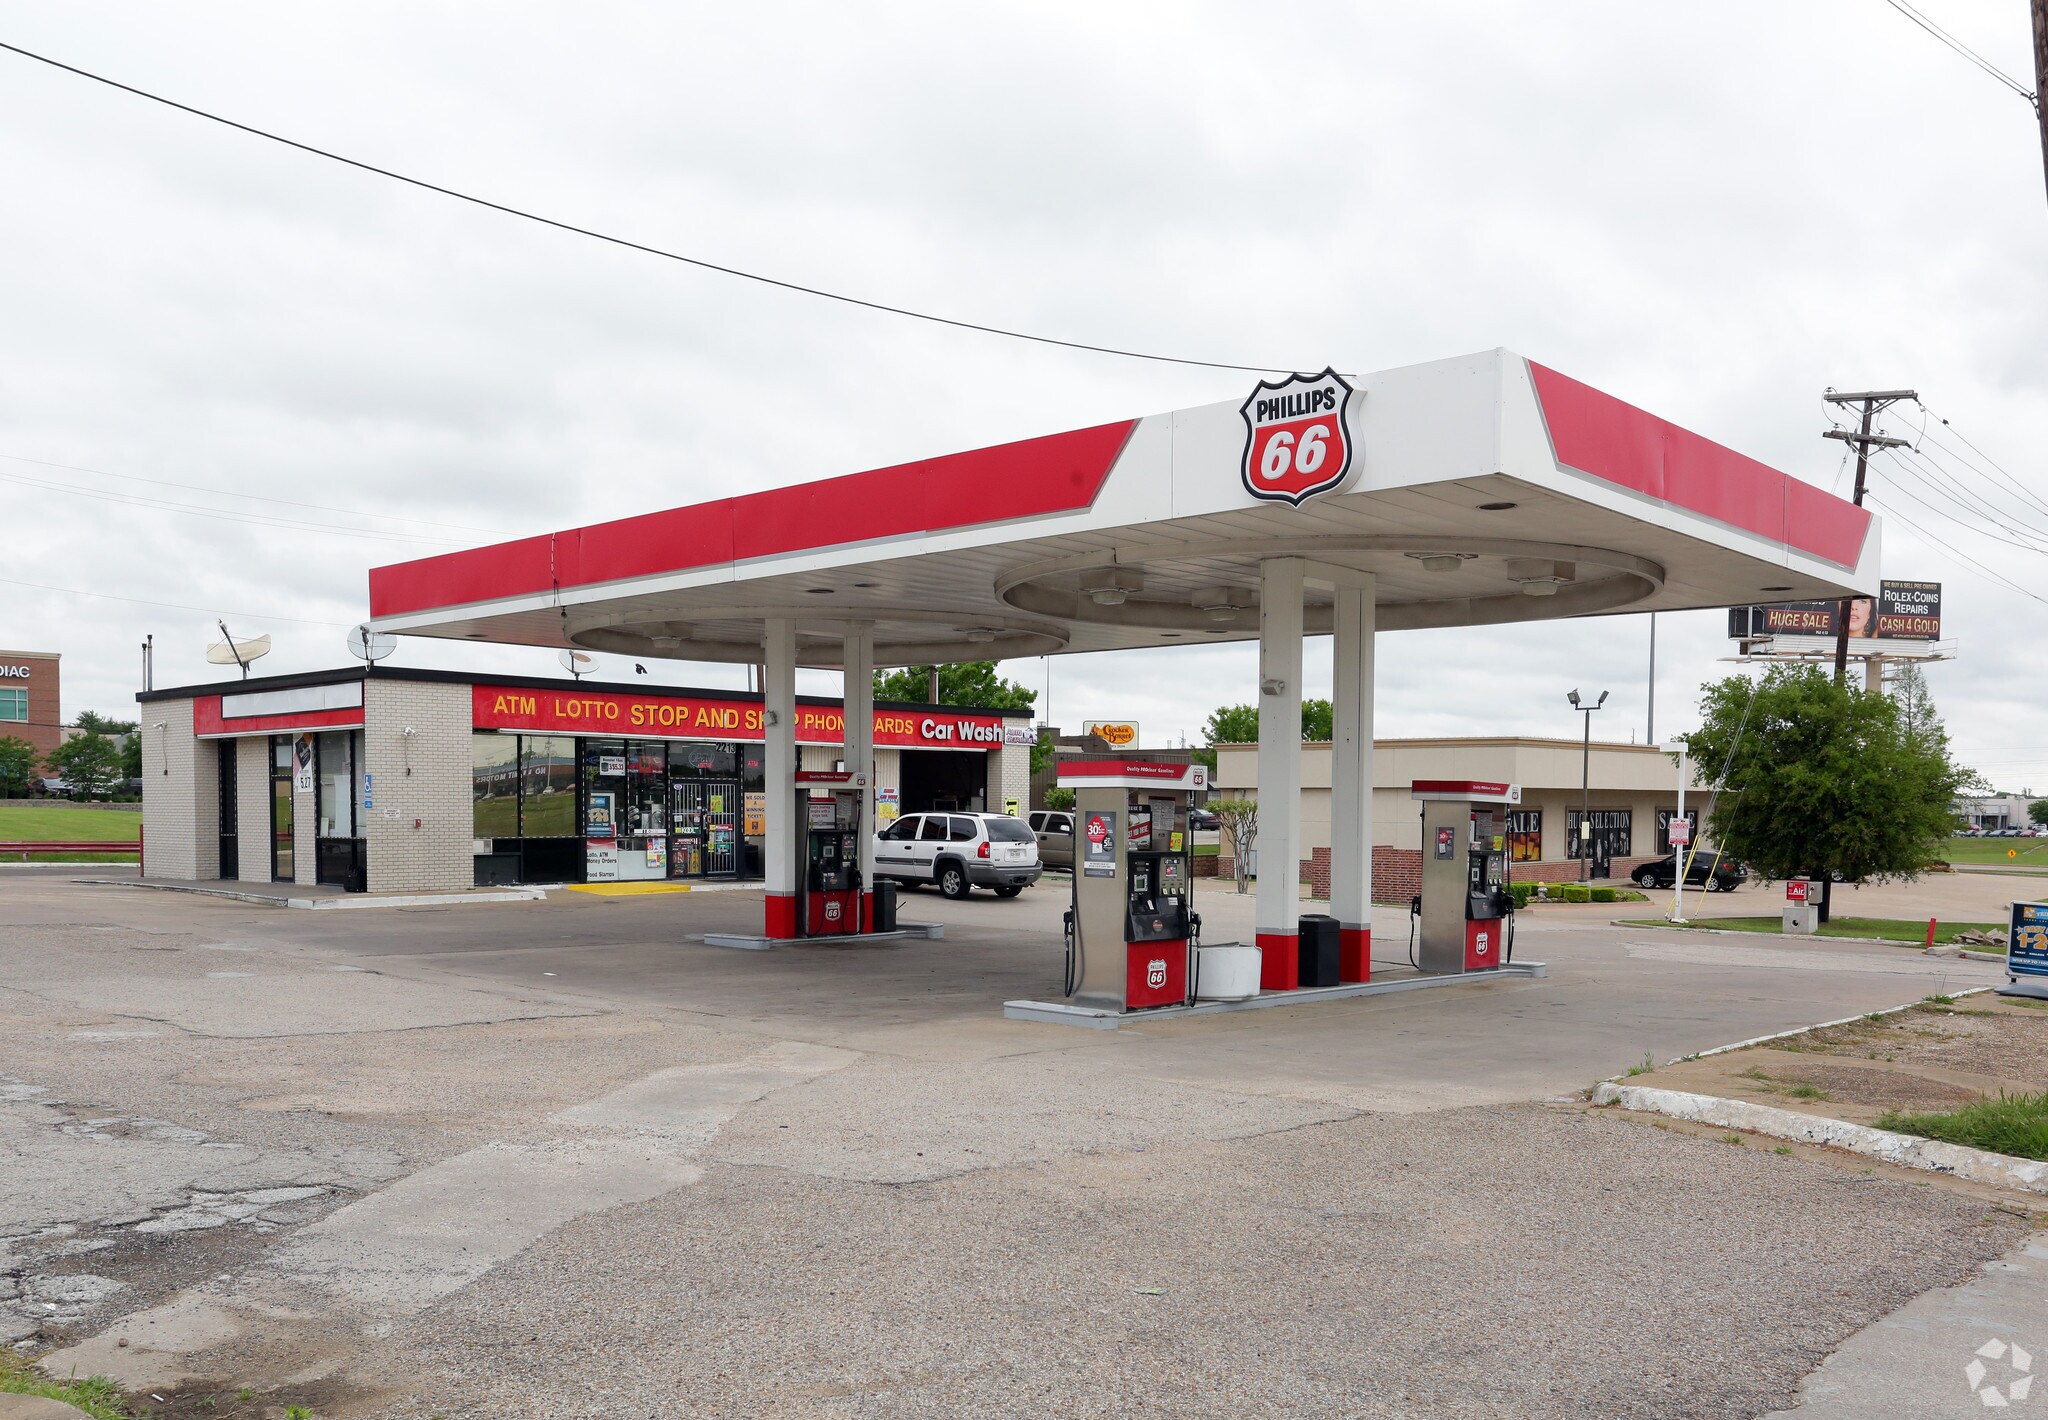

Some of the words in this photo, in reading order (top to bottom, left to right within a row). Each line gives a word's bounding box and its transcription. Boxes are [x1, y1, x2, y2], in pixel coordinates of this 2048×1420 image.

[1256, 386, 1336, 422] PHILLIPS
[1260, 424, 1331, 480] 66
[1894, 602, 1929, 614] REPAIRS
[1768, 611, 1800, 627] HUGE
[1880, 616, 1904, 632] CASH
[1906, 618, 1912, 632] 4
[1914, 618, 1939, 633] GOLD
[493, 695, 536, 715] ATM
[556, 699, 619, 720] LOTTO
[630, 704, 689, 726] STOP
[695, 708, 740, 729] AND
[804, 714, 844, 731] PHON
[873, 718, 914, 734] ARDS
[922, 718, 954, 740] Car
[958, 721, 1003, 742] Wash
[716, 742, 736, 754] 2213
[1590, 812, 1630, 828] SELECTION
[1659, 812, 1695, 829] SE
[1479, 942, 1486, 950] 66
[1150, 972, 1163, 983] 66
